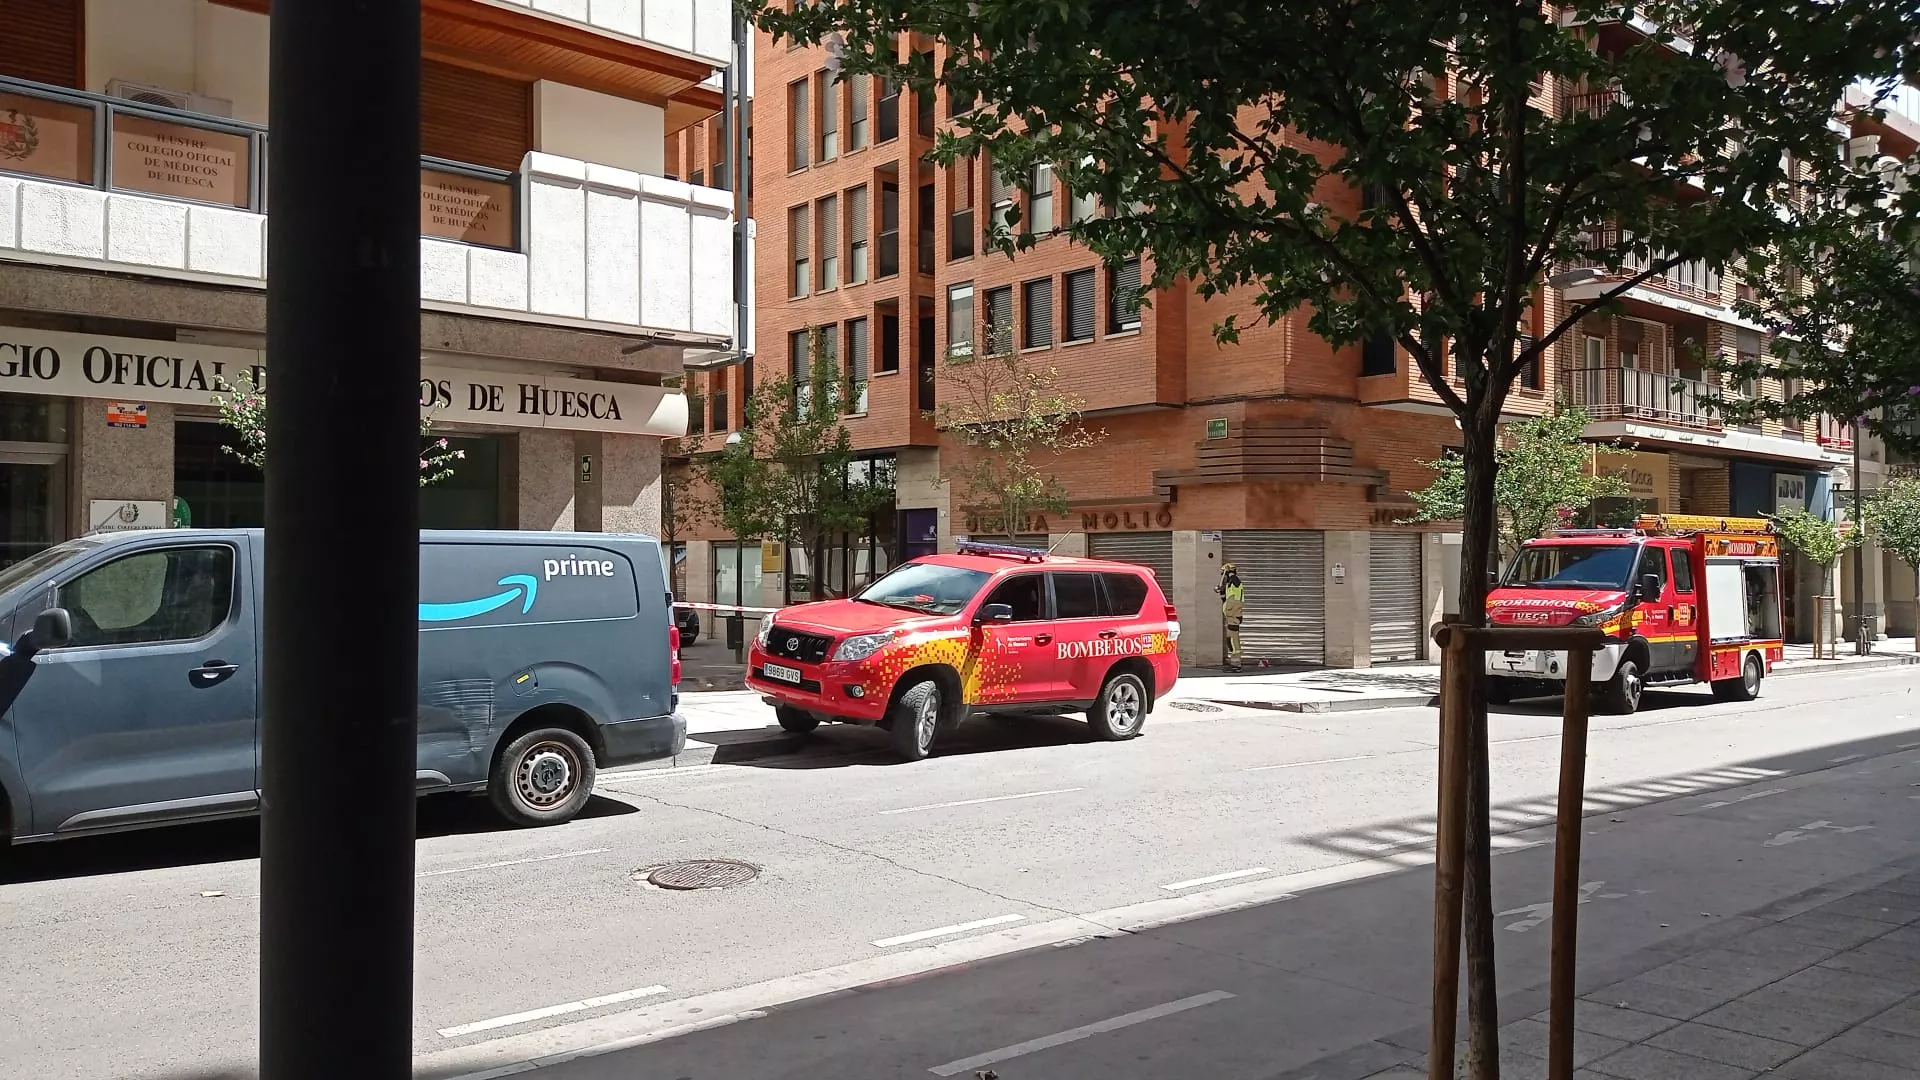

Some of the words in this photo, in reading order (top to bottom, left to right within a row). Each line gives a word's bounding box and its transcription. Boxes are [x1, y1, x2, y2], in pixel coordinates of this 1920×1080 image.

[156, 133, 208, 149] ILUSTRE
[127, 141, 184, 158] COLEGIO
[186, 151, 234, 167] OFICIAL
[144, 157, 161, 167] DE
[164, 159, 218, 177] MÉDICOS
[148, 170, 164, 180] DE
[167, 173, 214, 188] HUESCA
[439, 182, 480, 196] ILUSTRE
[422, 191, 461, 205] OLEGIO
[463, 198, 502, 212] OFICIAL
[429, 203, 443, 212] DE
[445, 206, 489, 220] MÉDICOS
[433, 215, 446, 225] DE
[448, 217, 487, 232] HUESCA
[83, 346, 233, 393] OFICIAL
[467, 383, 504, 413] DE
[517, 383, 622, 421] HUESCA
[1081, 511, 1172, 530] MOLIO
[543, 554, 615, 581] prime
[1512, 612, 1549, 621] IVECO
[1057, 637, 1142, 660] BOMBEROS
